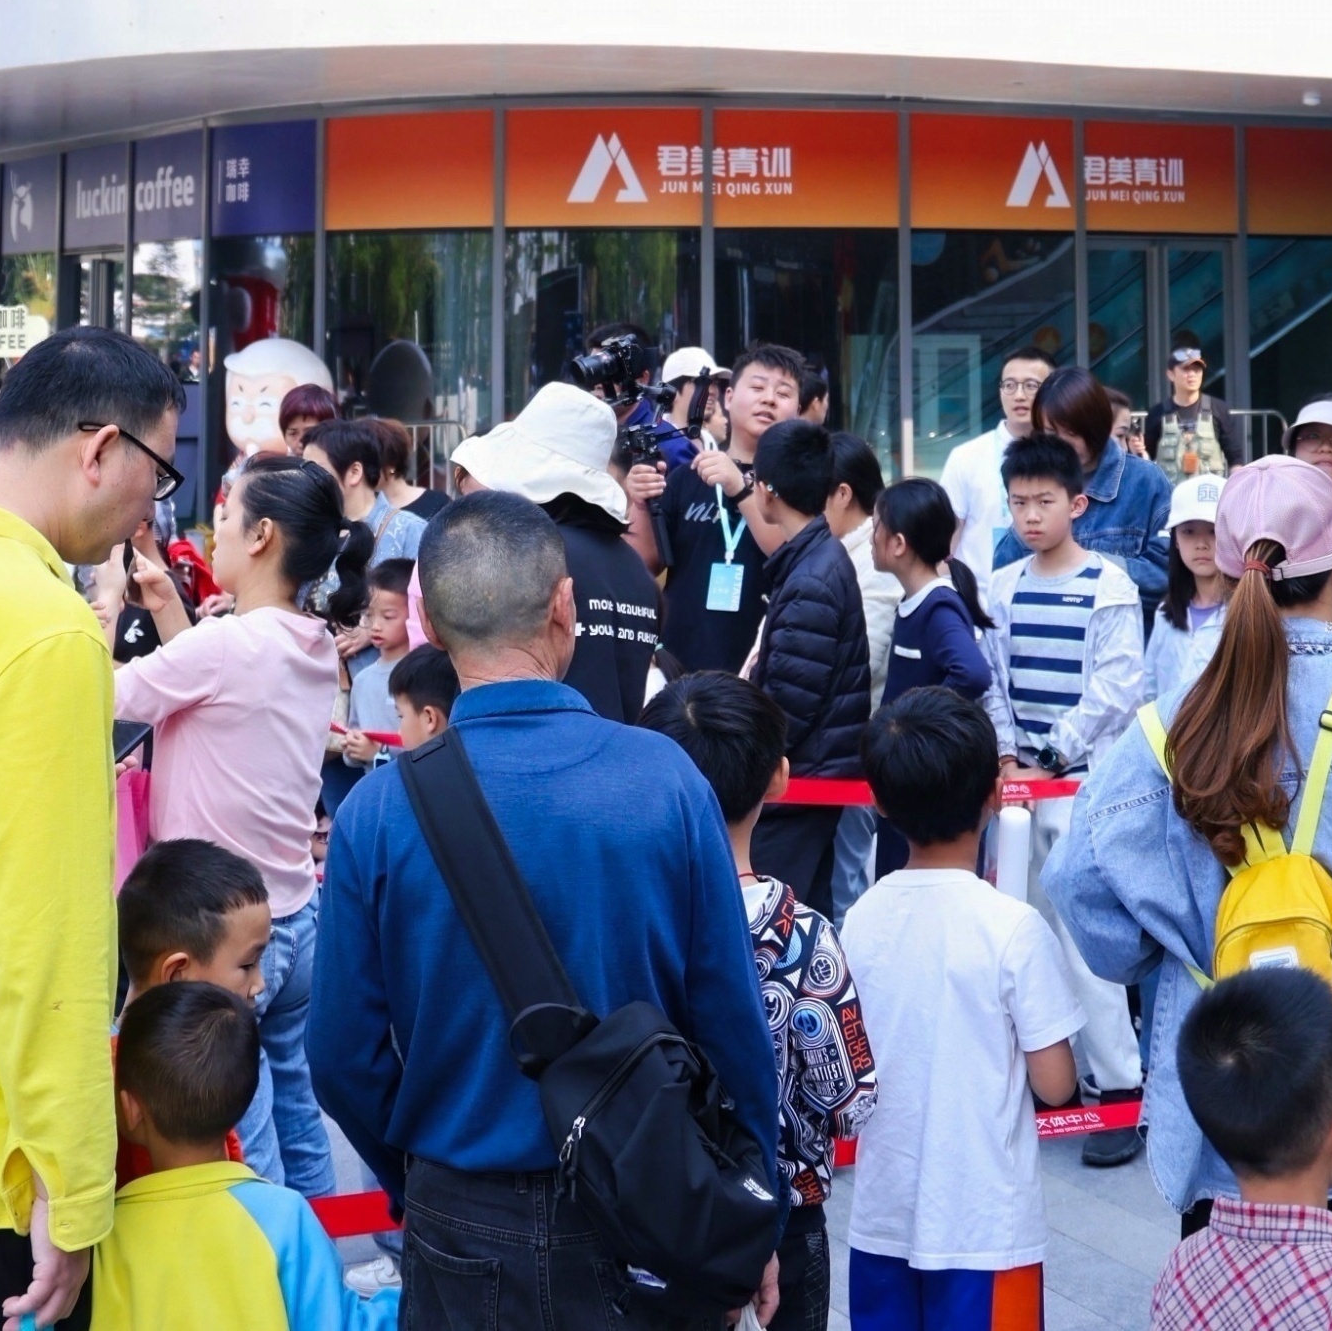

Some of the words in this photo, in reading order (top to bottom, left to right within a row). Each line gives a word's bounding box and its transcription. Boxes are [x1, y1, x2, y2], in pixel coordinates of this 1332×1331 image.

[225, 157, 250, 180] 瑞幸
[657, 145, 792, 178] 君美青训
[1083, 156, 1185, 187] 君美青训
[76, 173, 127, 219] luckin
[135, 165, 195, 212] coffee
[225, 181, 250, 204] 咖啡
[659, 181, 688, 194] JUN
[725, 182, 761, 198] QING
[764, 182, 793, 195] XUN
[1085, 190, 1107, 201] JUN
[1110, 190, 1130, 202] MEI
[1132, 190, 1161, 204] QING
[1163, 191, 1186, 203] XUN
